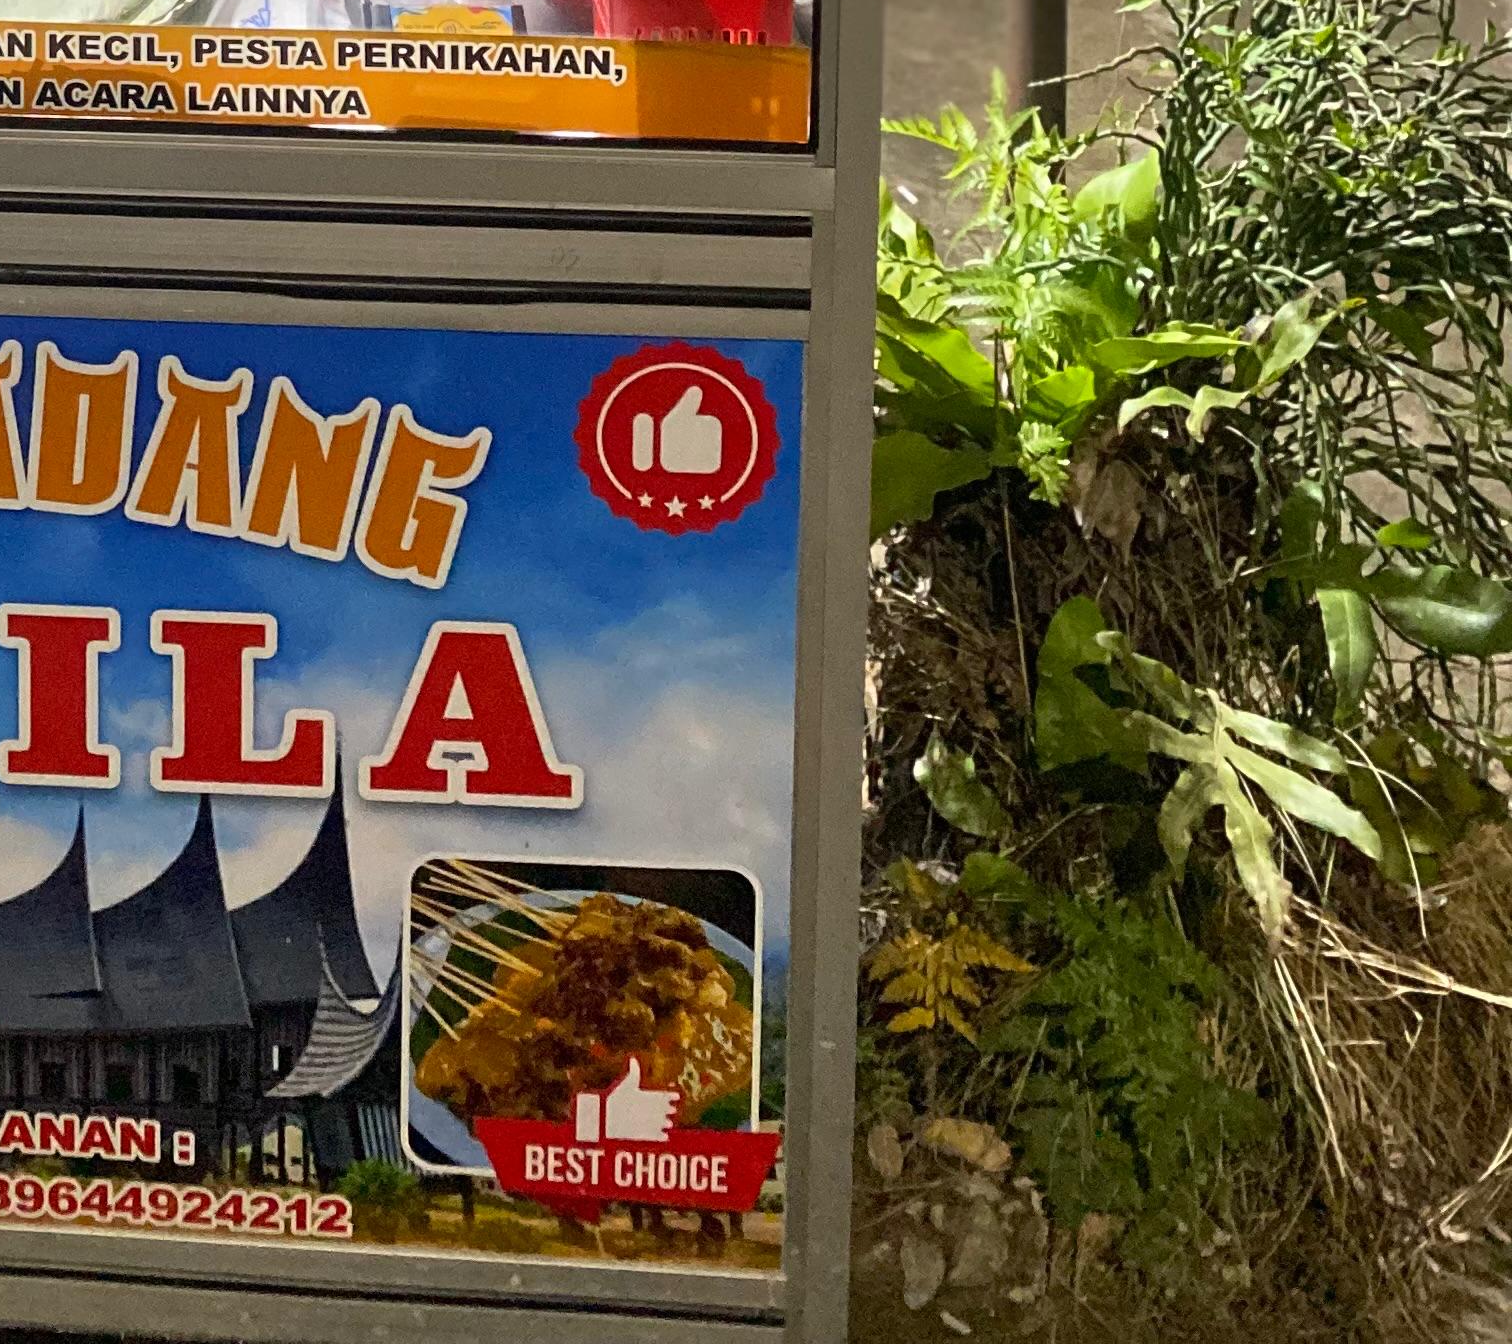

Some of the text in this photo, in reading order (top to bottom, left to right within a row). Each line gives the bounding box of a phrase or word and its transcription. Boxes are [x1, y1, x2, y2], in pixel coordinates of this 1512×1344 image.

[45, 31, 182, 70] KECIL,
[191, 34, 327, 69] PESTA
[334, 39, 627, 86] PERNIKAHAN,
[33, 78, 177, 114] ACARA
[185, 82, 372, 120] LAINNYA
[524, 1144, 729, 1194] BEST CHOICE
